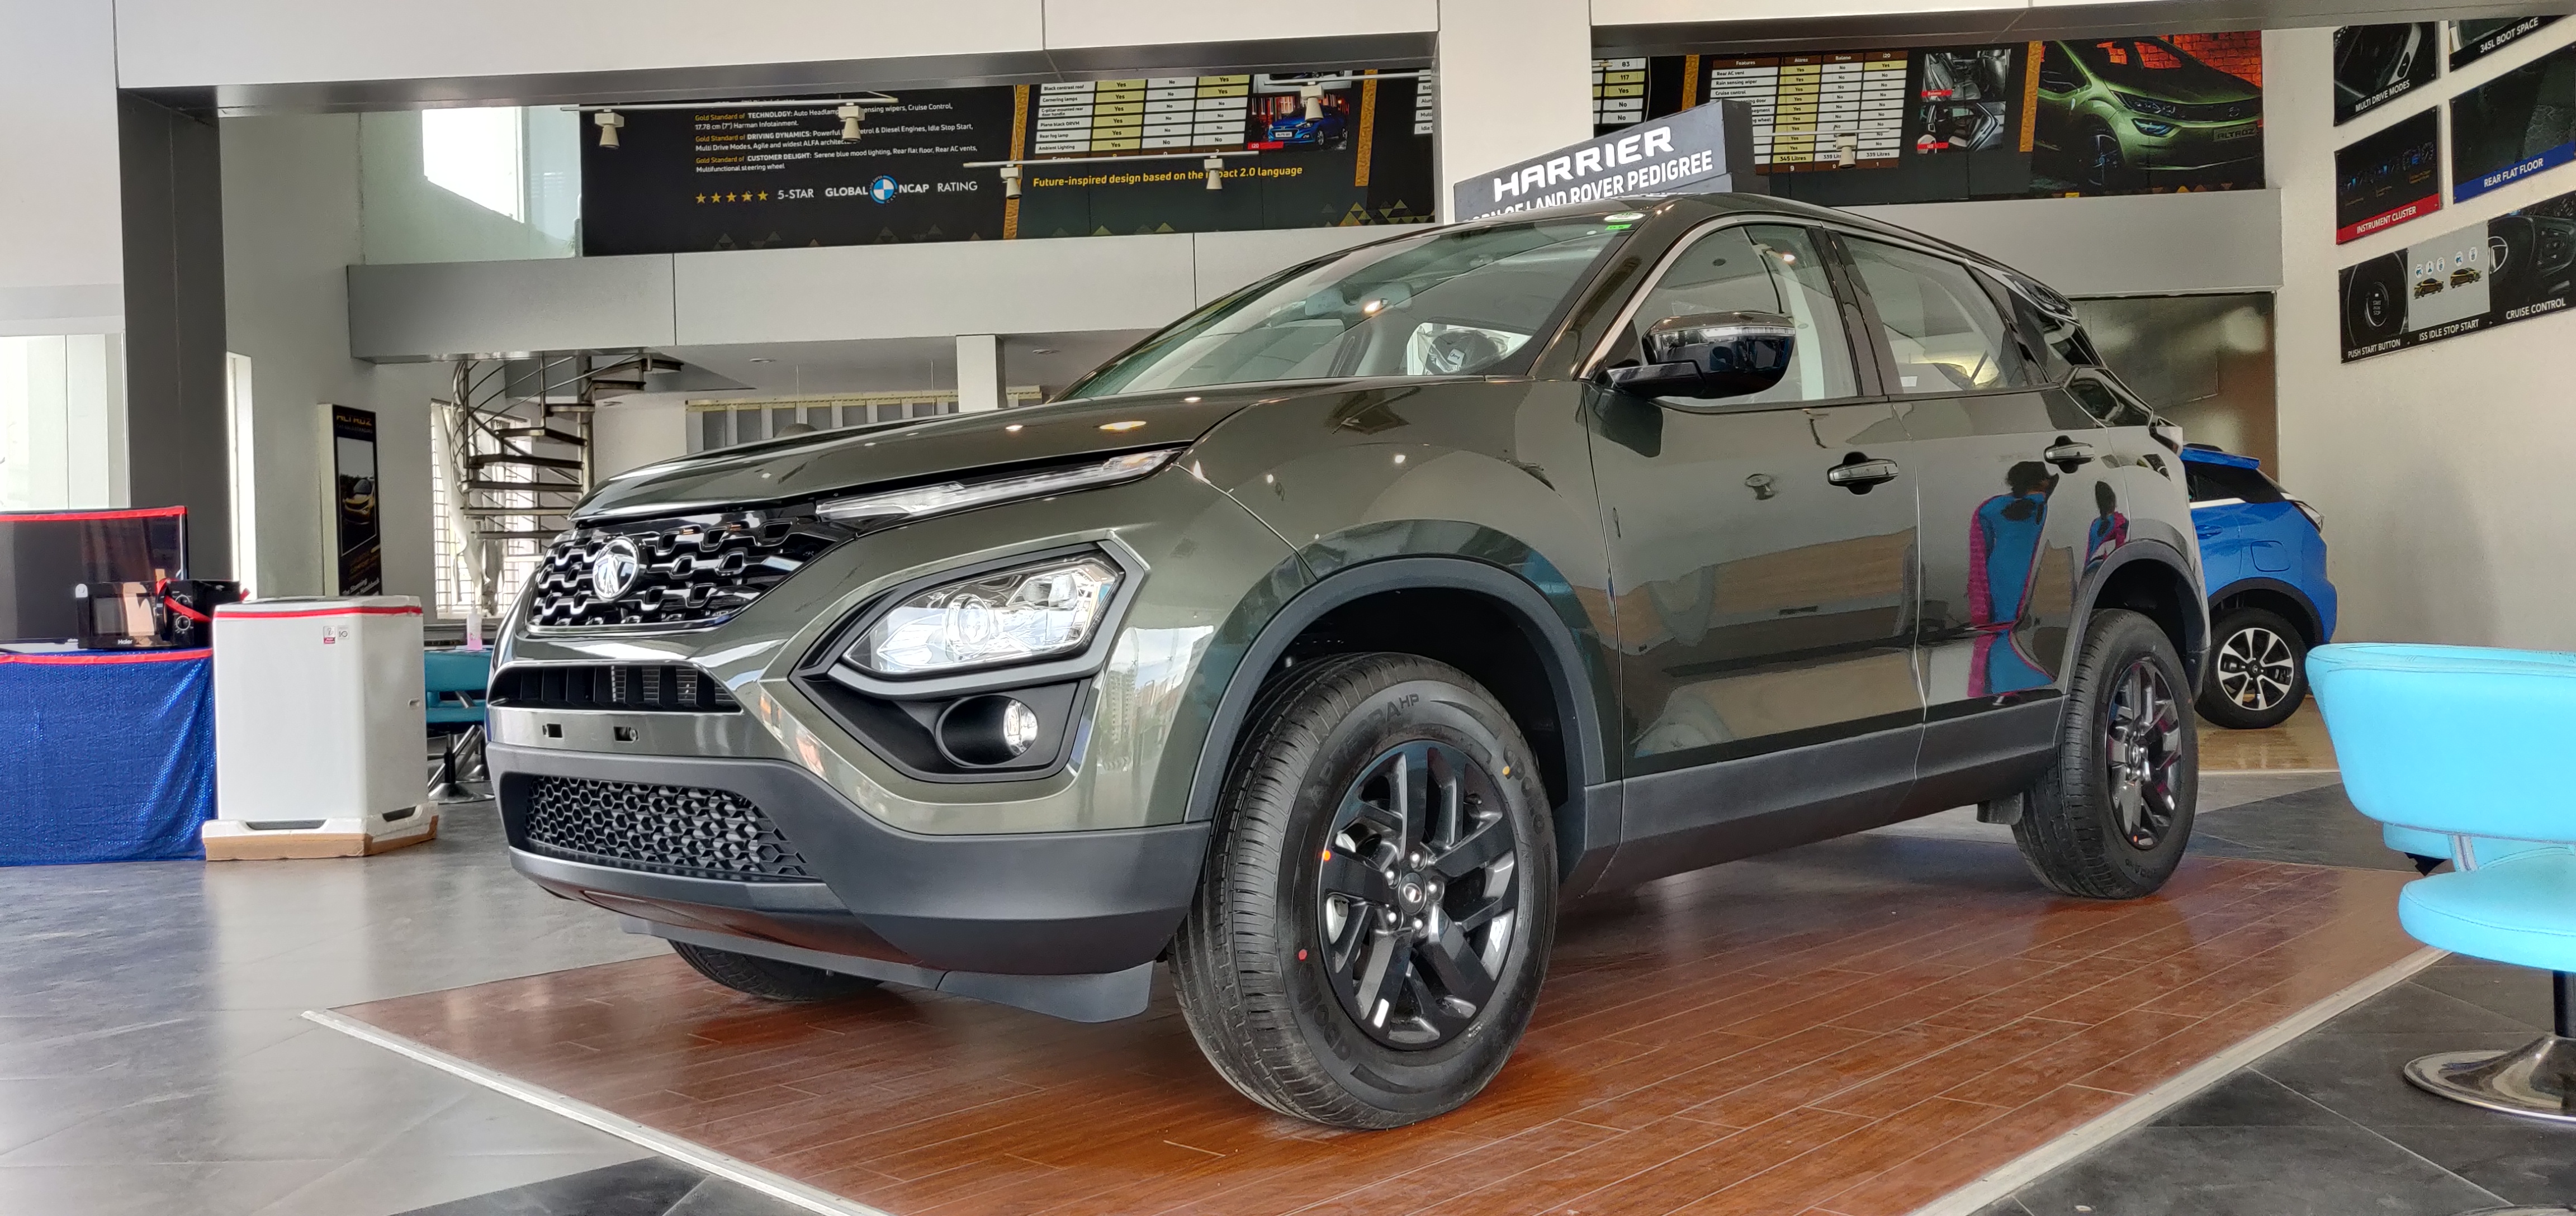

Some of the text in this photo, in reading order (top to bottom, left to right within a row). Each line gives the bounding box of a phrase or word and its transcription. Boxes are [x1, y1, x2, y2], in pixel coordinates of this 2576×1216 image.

[2480, 17, 2539, 53] 345L BOOT SPACE
[2355, 79, 2410, 112] MULTI DRIVE MODES
[1494, 126, 1674, 202] HARRIER
[1571, 177, 1624, 203] ROVER
[1627, 149, 1713, 191] PEDIGREE
[2484, 158, 2544, 188] REAR FLAT FLOOR
[1033, 175, 1107, 187] Future-inspired
[1109, 173, 1141, 185] design
[1143, 172, 1172, 182] based
[1187, 170, 1204, 179] the
[1240, 167, 1256, 177] 2.0
[1257, 167, 1303, 178] language
[777, 180, 978, 200] 5-STAR GLOBAL NCAP RATING
[2356, 206, 2417, 234] INSTRUMENT CLUSTER
[2506, 297, 2566, 320] CRUISE CONTROL
[2419, 319, 2479, 341] ISS IDLE STOP START
[2348, 338, 2401, 359] PUSH START BUTTON
[1399, 692, 1420, 709] HP
